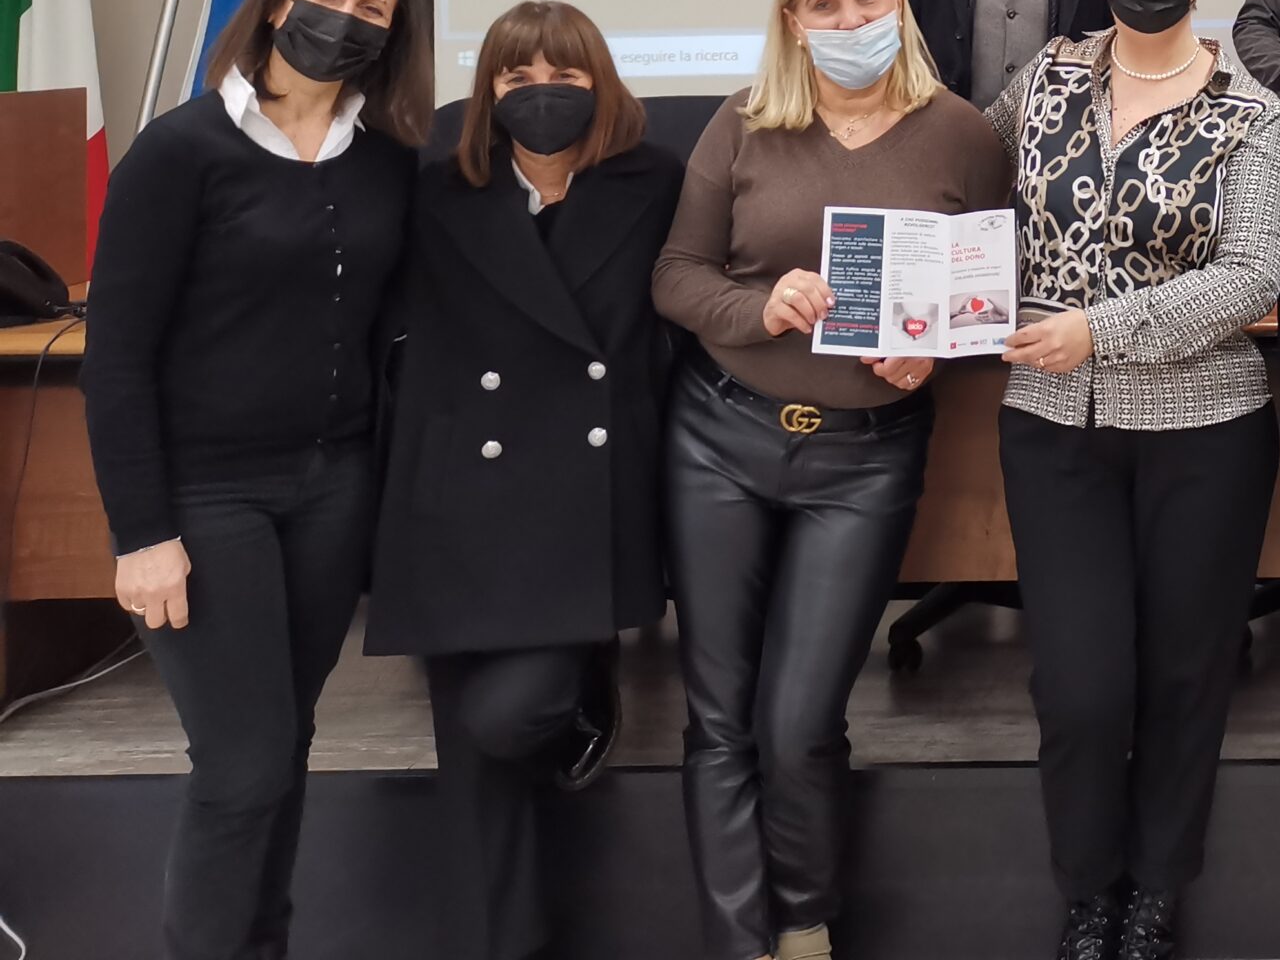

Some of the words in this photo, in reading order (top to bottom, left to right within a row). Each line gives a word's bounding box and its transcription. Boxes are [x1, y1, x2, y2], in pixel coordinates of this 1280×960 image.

[620, 52, 677, 67] eseguire
[680, 49, 692, 62] la
[694, 49, 739, 62] ricerca
[951, 246, 982, 256] CULTURA
[965, 253, 986, 261] DONO
